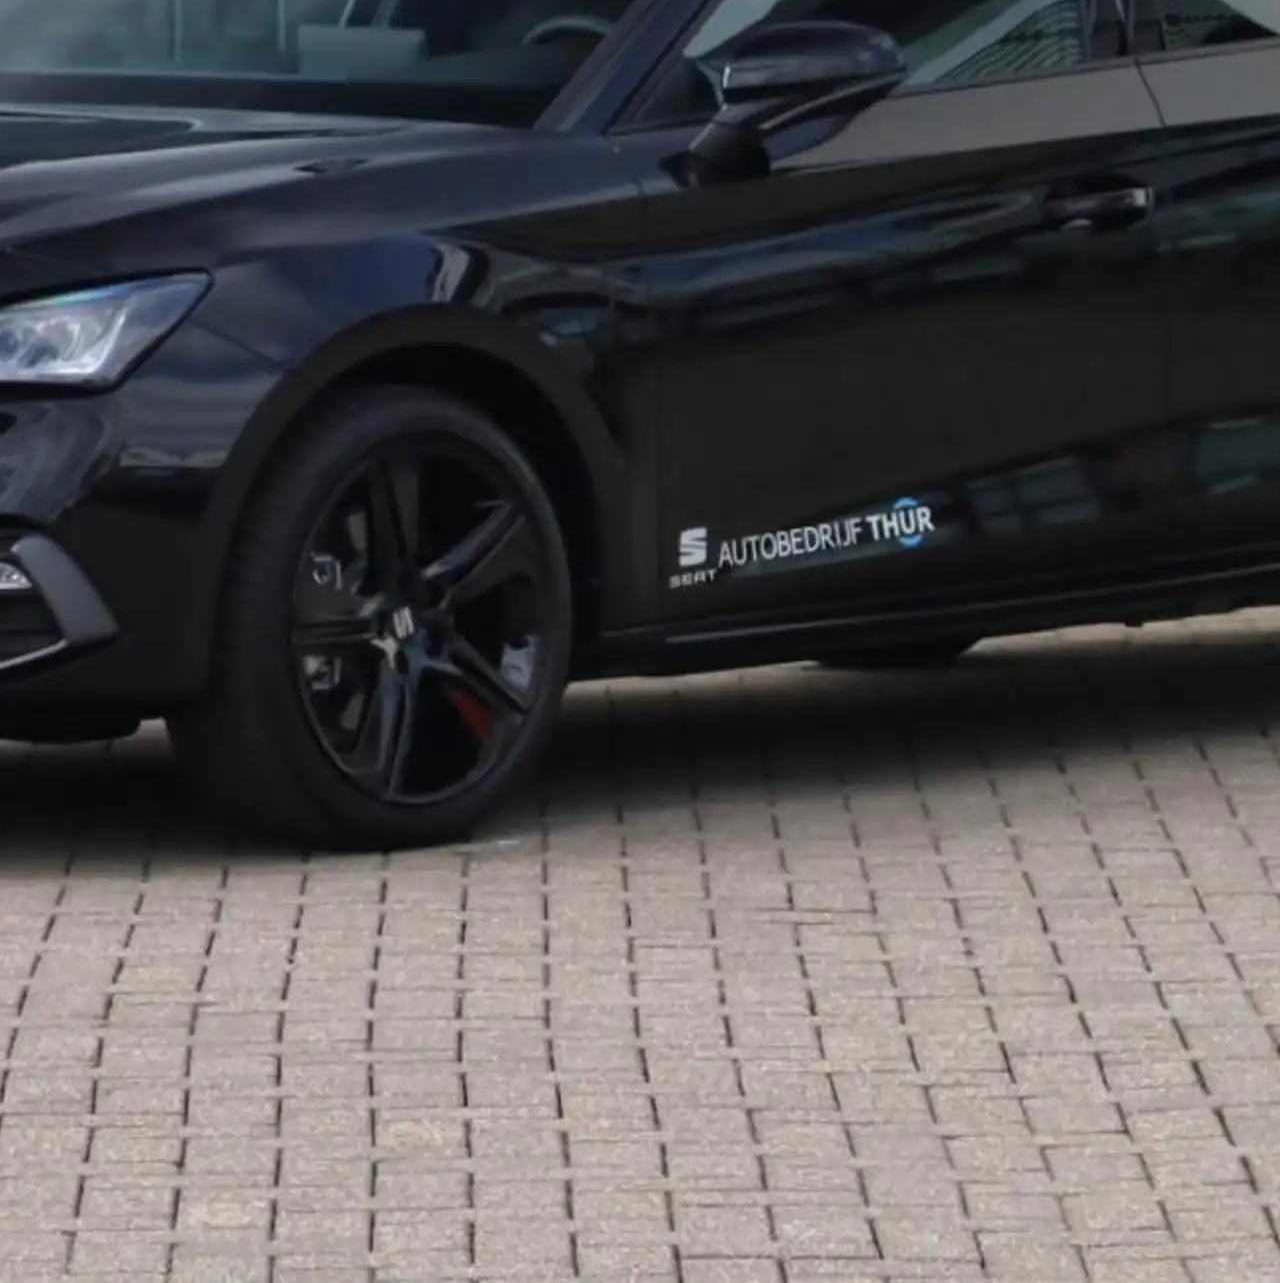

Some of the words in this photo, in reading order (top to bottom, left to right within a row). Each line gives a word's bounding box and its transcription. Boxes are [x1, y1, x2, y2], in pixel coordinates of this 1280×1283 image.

[718, 517, 864, 569] AUTOBEDRIJF
[865, 505, 936, 542] THUR
[669, 568, 718, 590] SEAT
